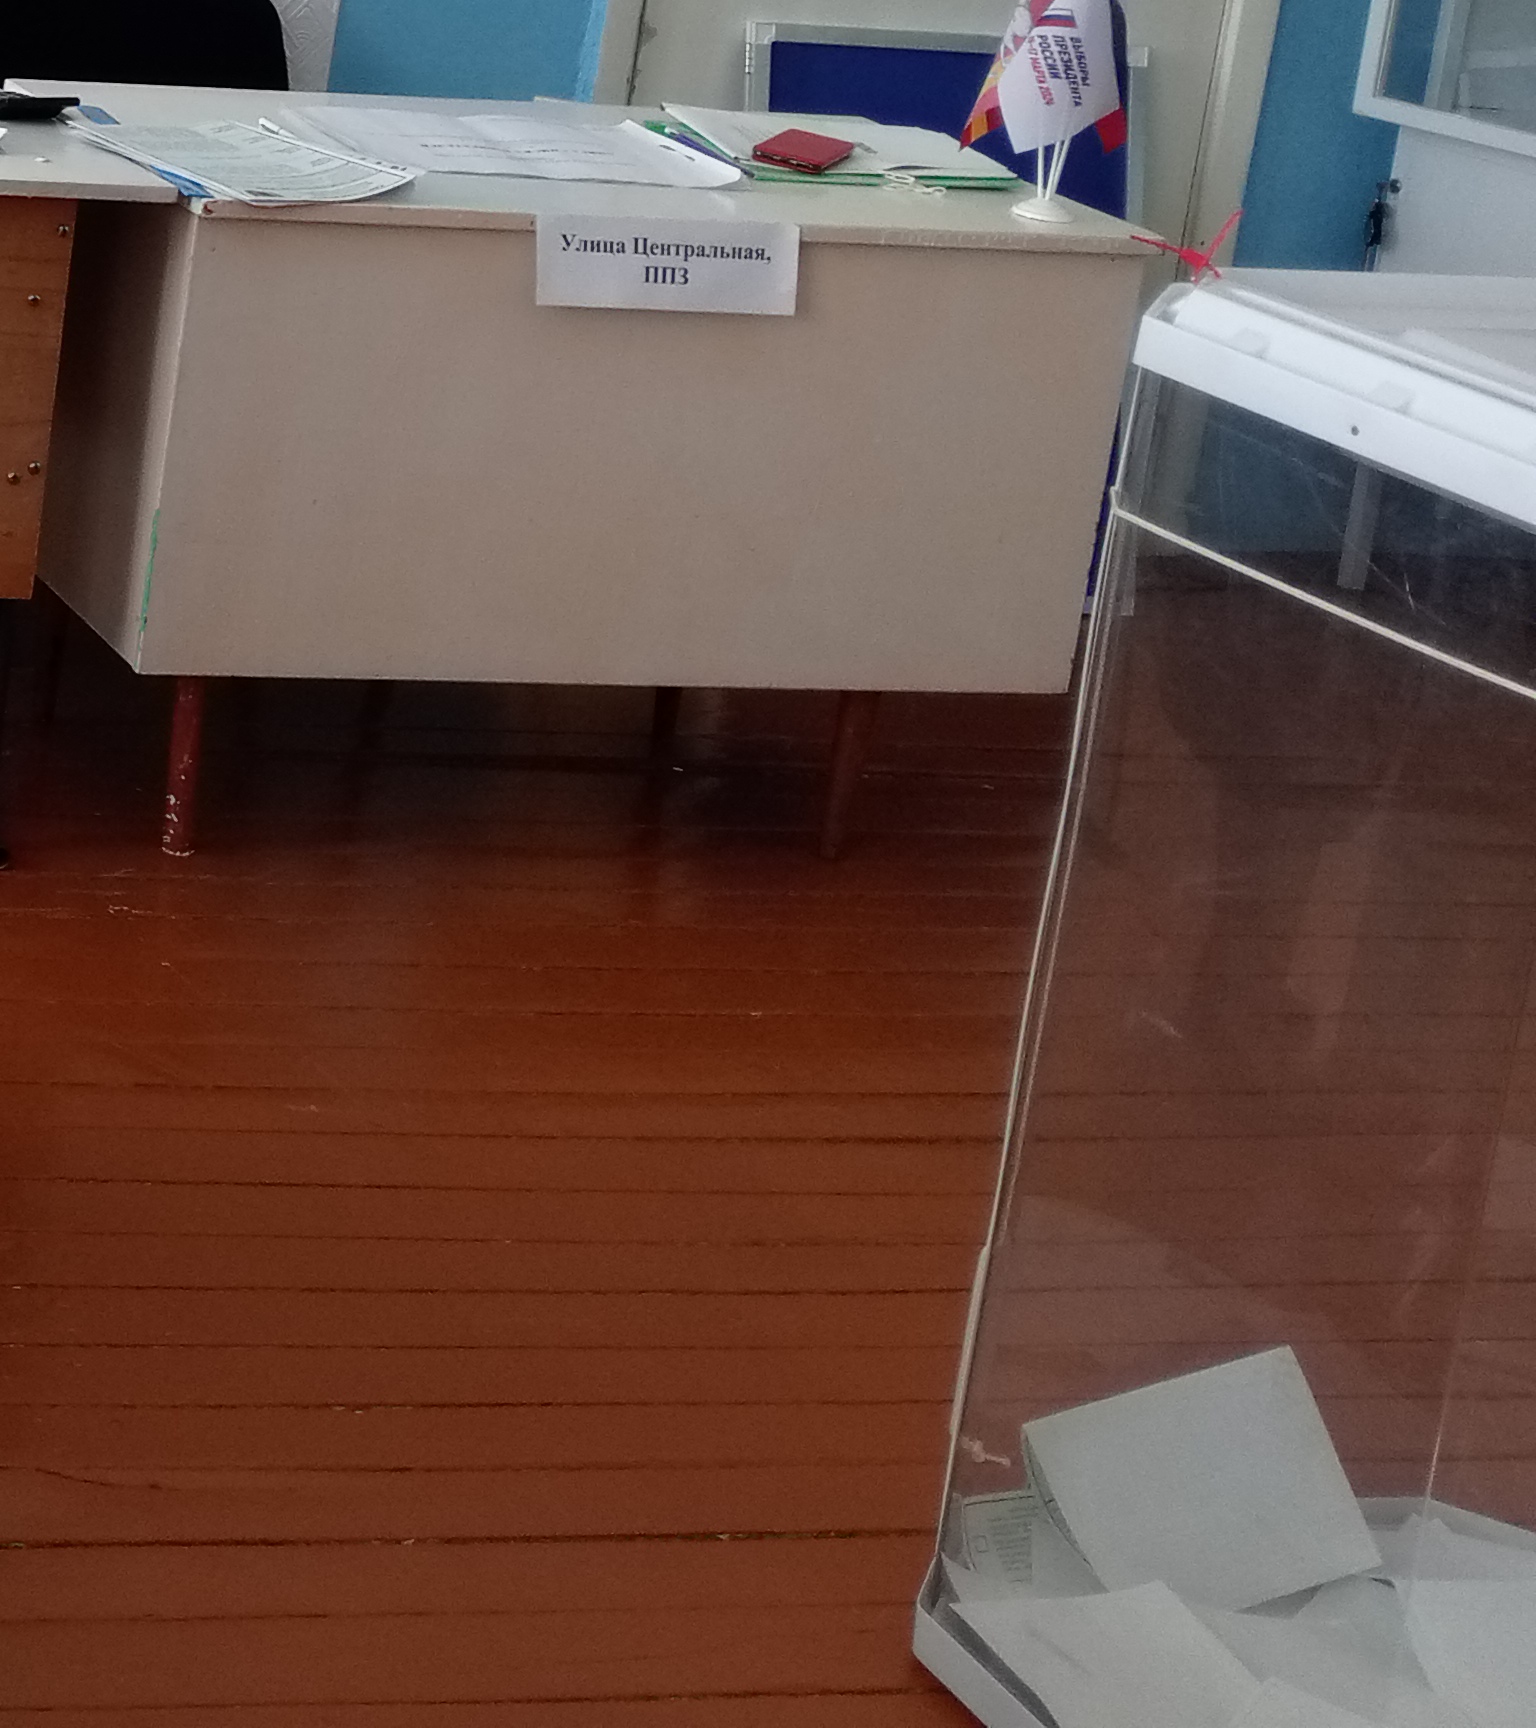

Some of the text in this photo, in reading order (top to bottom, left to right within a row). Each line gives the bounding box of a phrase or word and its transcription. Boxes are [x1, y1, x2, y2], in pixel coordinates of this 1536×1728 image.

[1036, 34, 1062, 80] РОССИИ
[1051, 34, 1083, 107] ПРЕЗИДЕНТА
[1069, 36, 1090, 87] ВЫБОРЫ
[560, 233, 772, 265] Улица Центральная,
[643, 265, 690, 286] ППЗ
